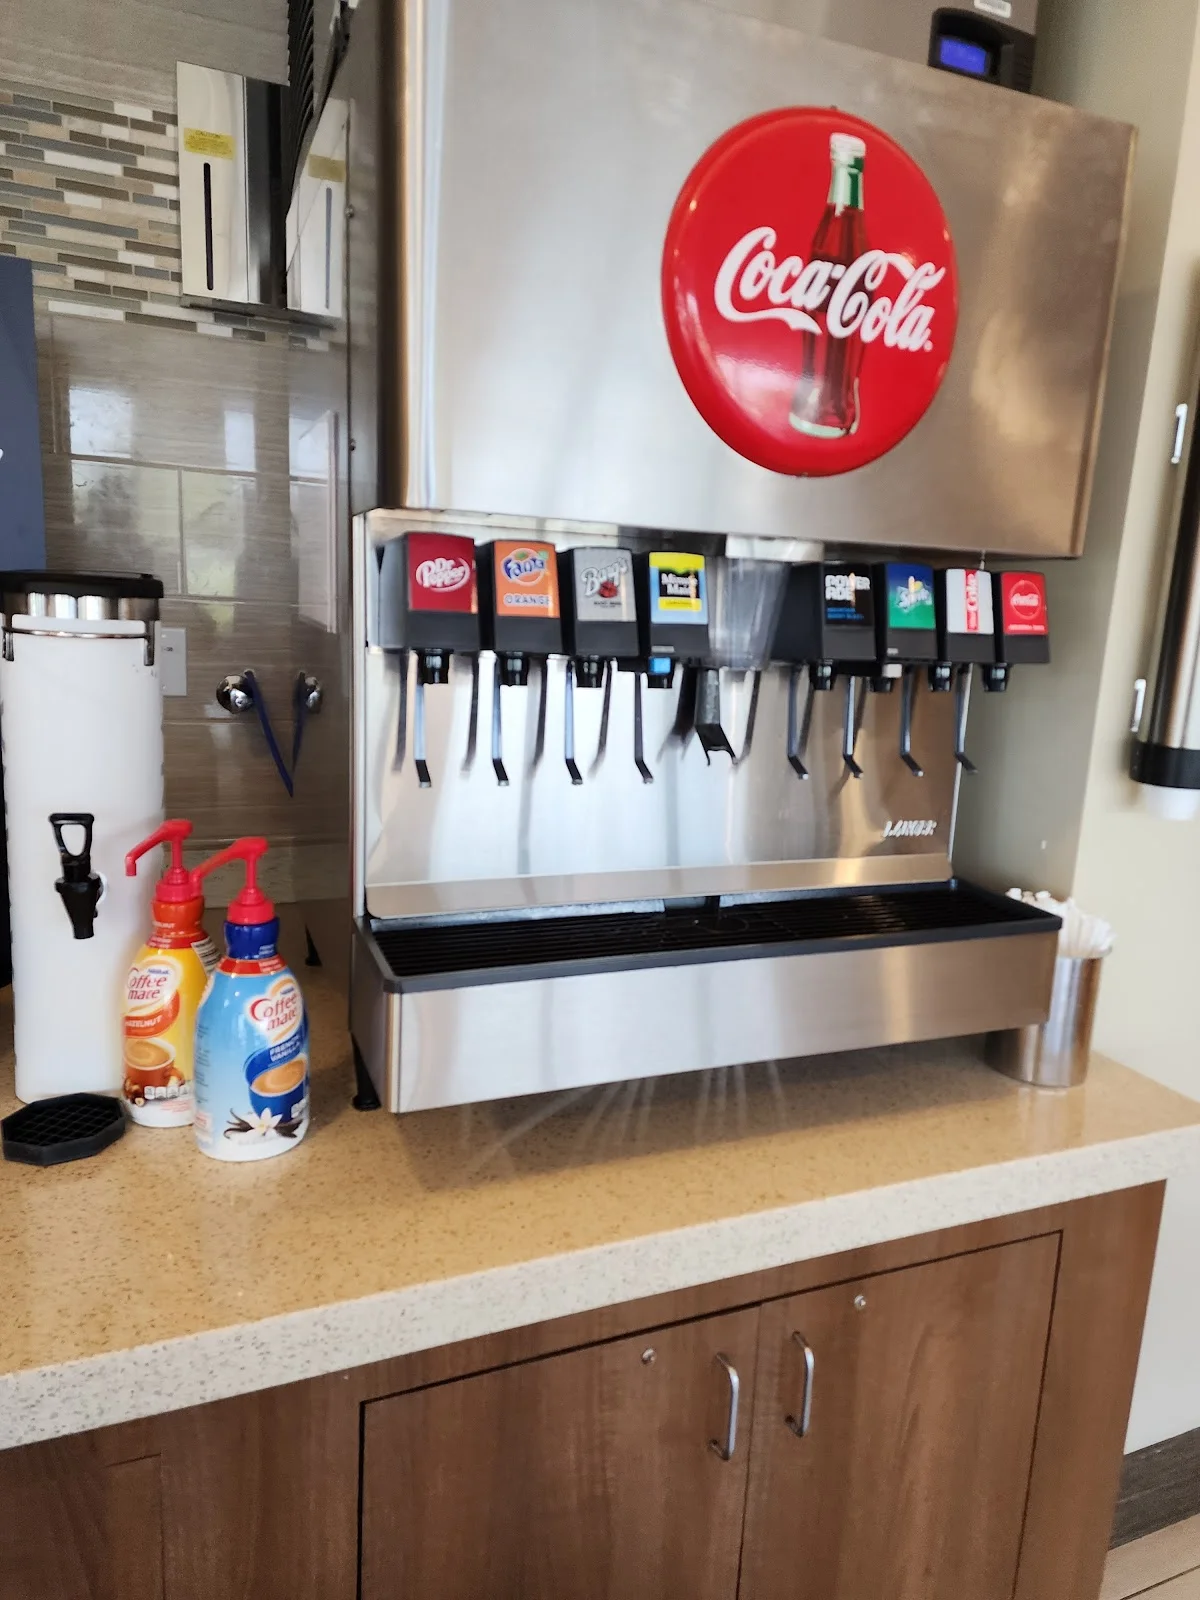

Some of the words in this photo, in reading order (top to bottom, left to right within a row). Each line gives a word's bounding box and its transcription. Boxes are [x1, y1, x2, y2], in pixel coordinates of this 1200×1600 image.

[420, 560, 466, 588] Pepper
[435, 557, 456, 571] Dr
[503, 557, 545, 580] Fanta
[250, 993, 298, 1021] Coffee
